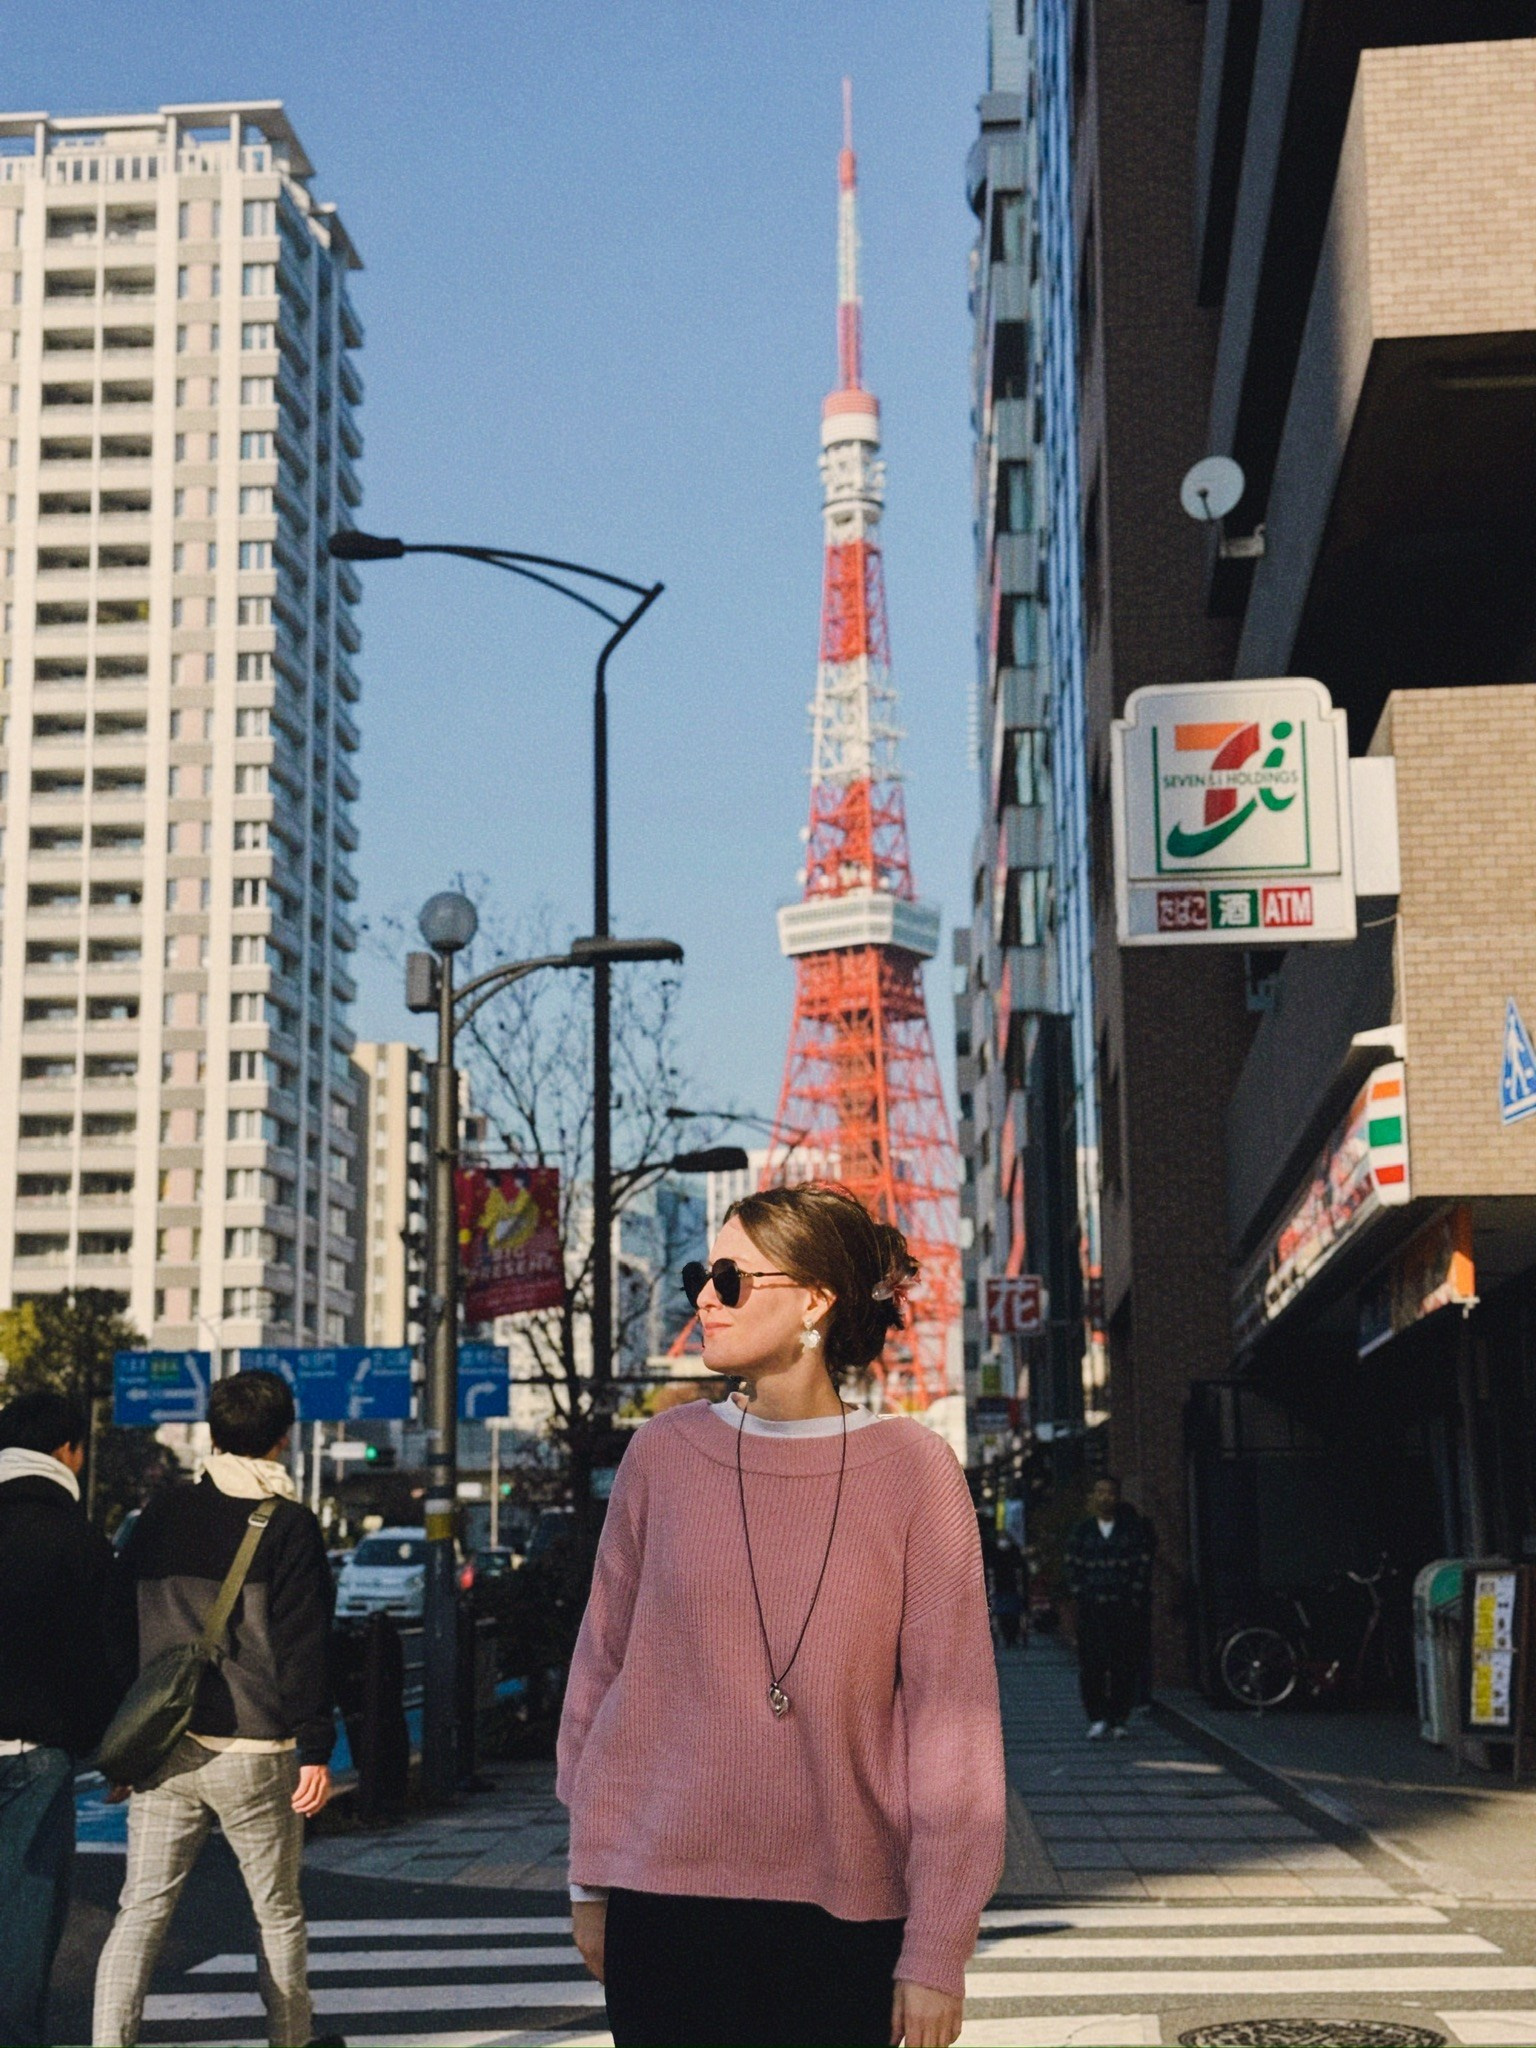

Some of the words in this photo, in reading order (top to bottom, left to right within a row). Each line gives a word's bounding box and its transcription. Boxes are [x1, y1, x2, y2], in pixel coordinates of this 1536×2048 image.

[1163, 772, 1205, 789] SEVEN
[1226, 768, 1299, 786] HOLDINGS
[1159, 896, 1207, 927] たばこ
[1218, 892, 1252, 926] 酒
[1265, 890, 1311, 924] ATM
